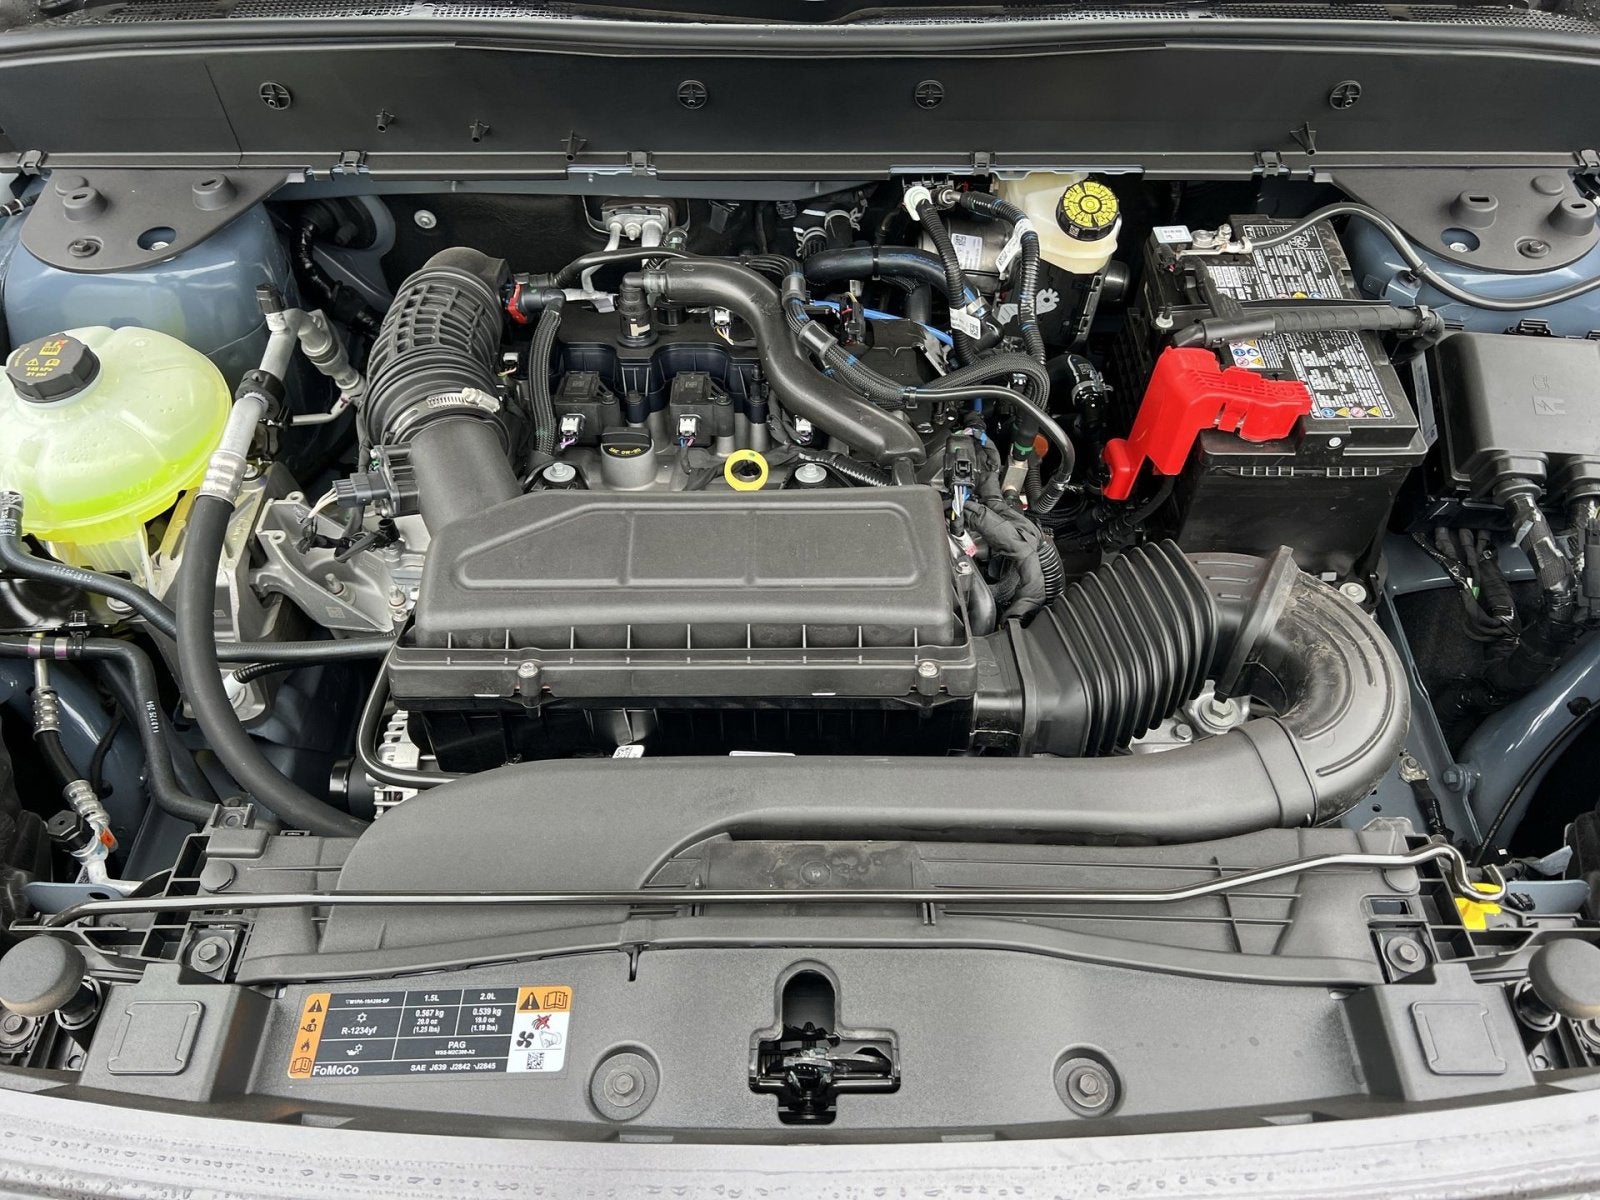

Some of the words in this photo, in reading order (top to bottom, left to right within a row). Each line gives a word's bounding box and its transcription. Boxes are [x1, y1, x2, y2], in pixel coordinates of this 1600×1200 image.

[424, 994, 440, 1002] 1.5L
[479, 992, 497, 1000] 2.0L
[415, 1009, 434, 1018] 0.567
[435, 1009, 445, 1019] kg
[472, 1007, 492, 1016] 0.539
[492, 1007, 502, 1017] kg
[341, 1026, 377, 1036] R-1234yf
[428, 1025, 441, 1034] lbs)
[470, 1024, 486, 1033] (1.19
[486, 1023, 498, 1032] lbs)
[447, 1041, 466, 1049] PAG
[312, 1064, 359, 1076] FoMoCo
[410, 1064, 427, 1072] SAE
[429, 1063, 447, 1071] J639
[450, 1063, 470, 1071] J2842
